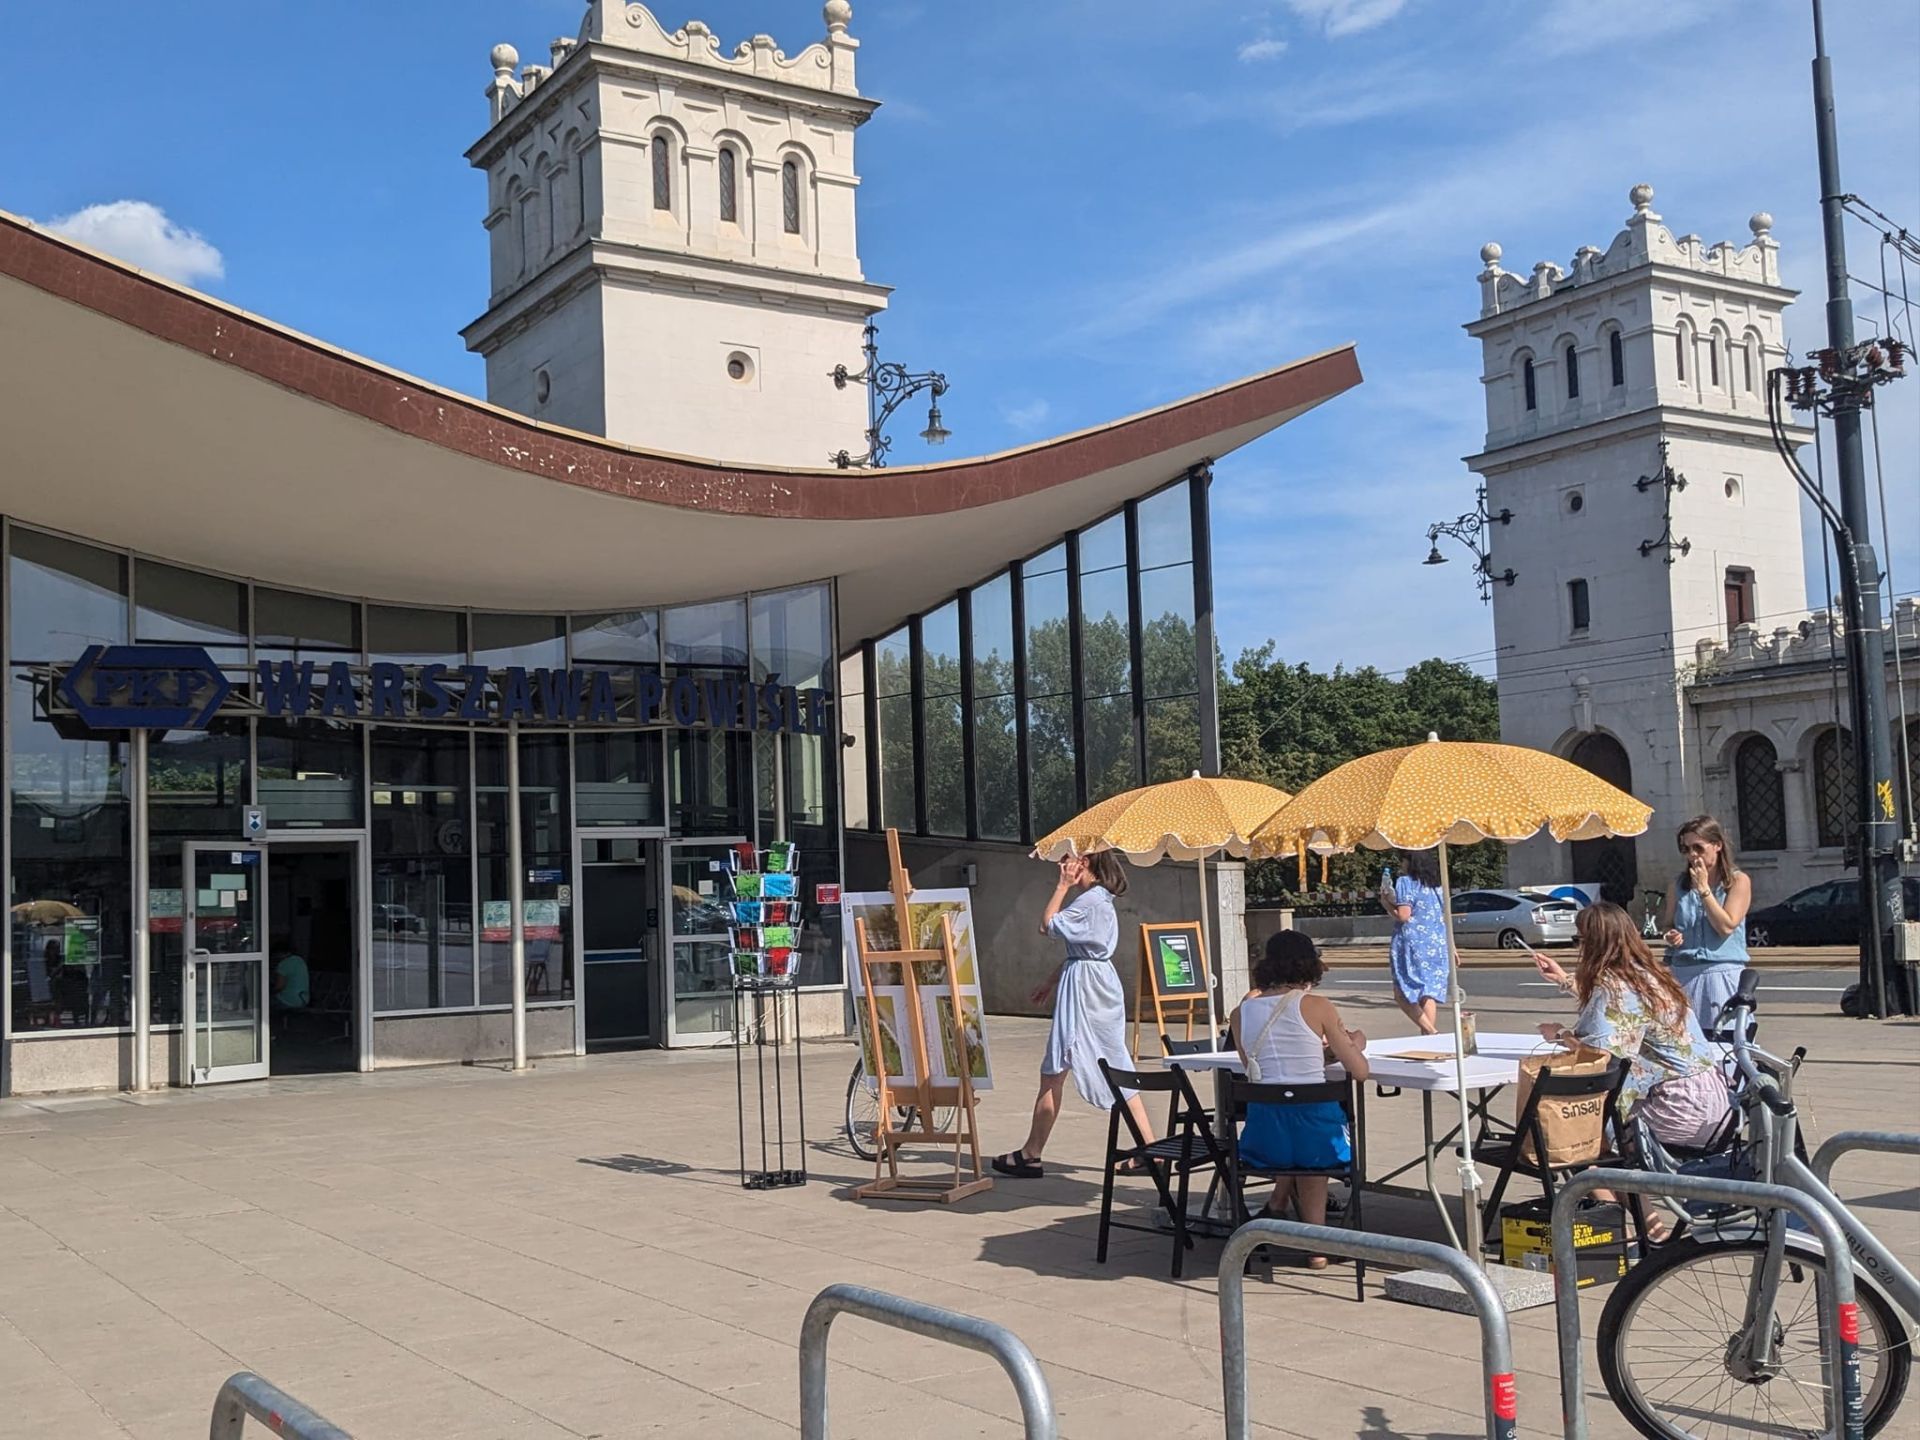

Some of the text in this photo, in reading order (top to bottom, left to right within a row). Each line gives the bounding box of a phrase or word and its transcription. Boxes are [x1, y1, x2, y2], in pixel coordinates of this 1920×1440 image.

[94, 671, 209, 706] PKP
[258, 660, 828, 735] WARSZAWA POWIŚLE
[1561, 1099, 1602, 1119] sinsay
